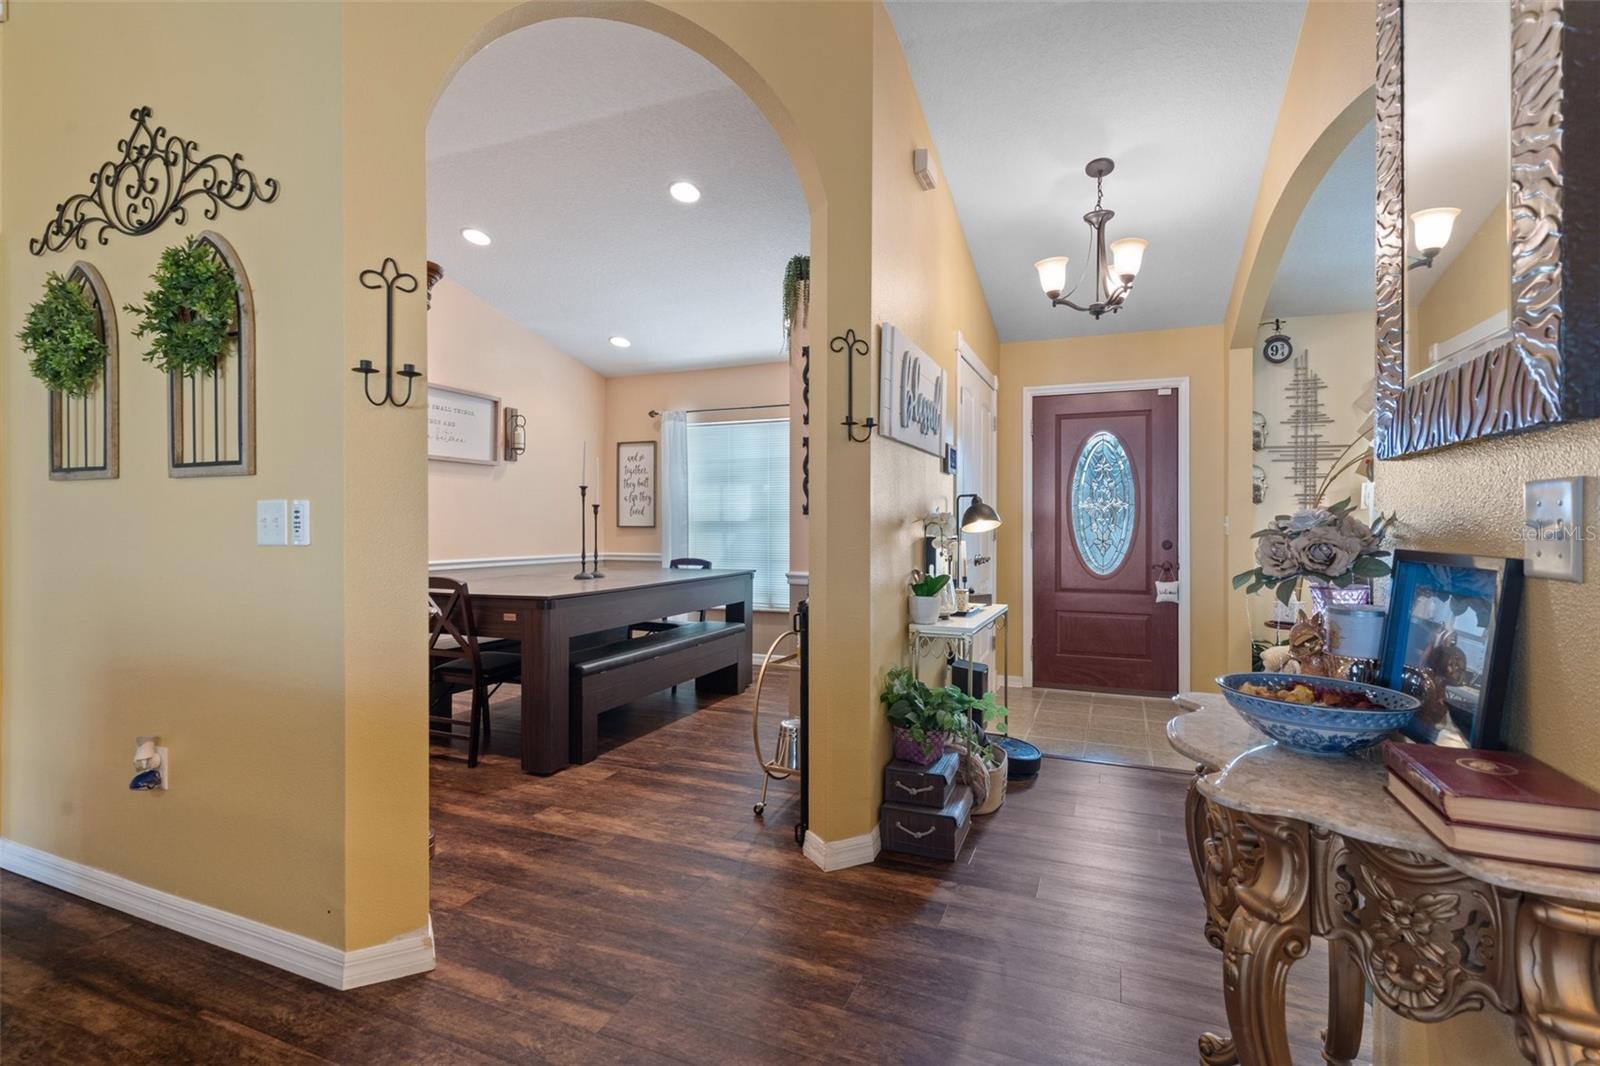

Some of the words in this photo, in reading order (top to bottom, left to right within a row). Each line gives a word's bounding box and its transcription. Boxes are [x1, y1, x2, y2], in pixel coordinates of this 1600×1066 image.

[627, 451, 638, 462] and
[624, 478, 635, 492] they
[637, 477, 648, 488] built
[639, 491, 651, 505] they
